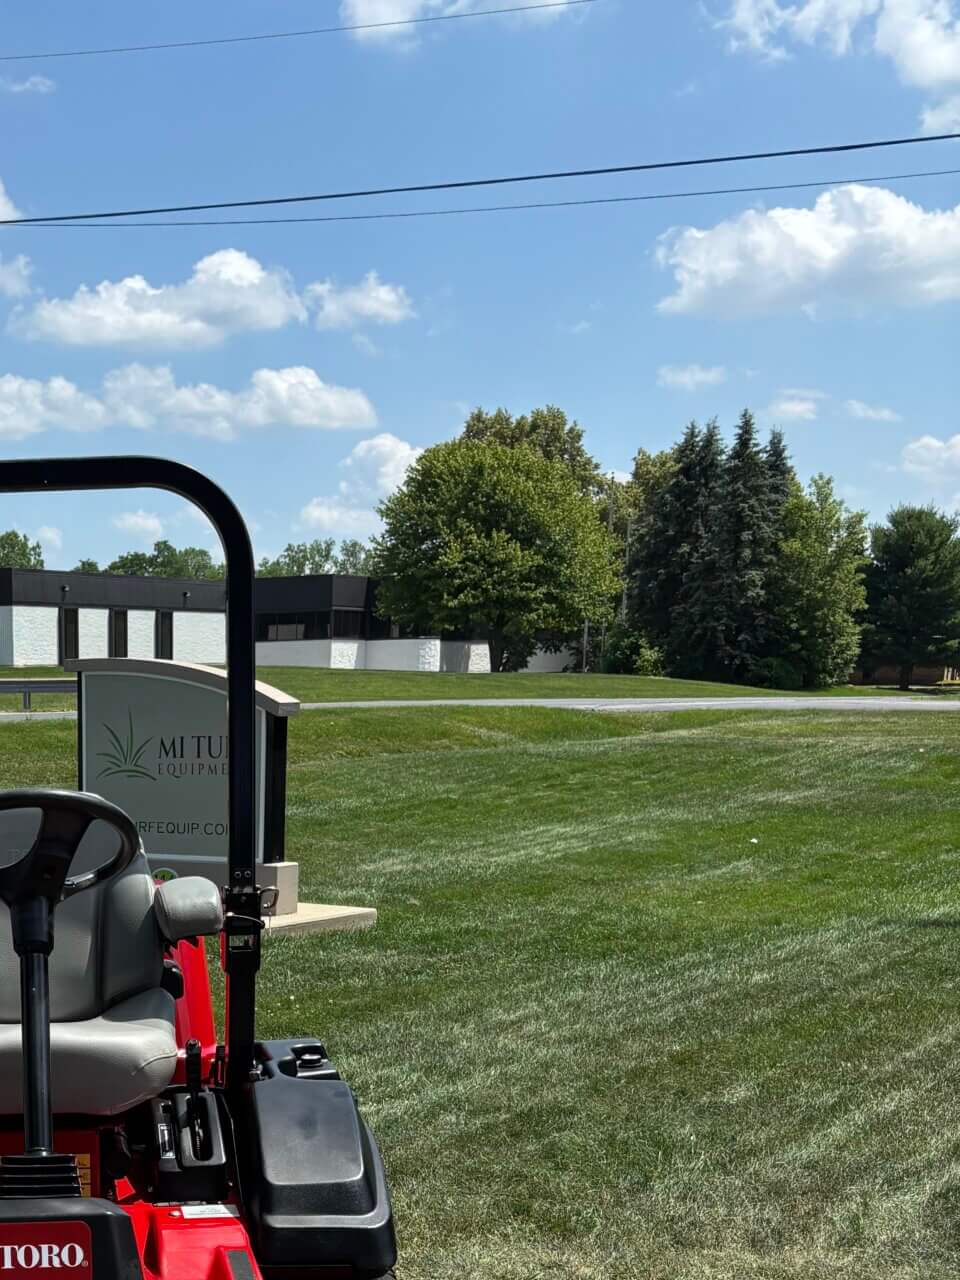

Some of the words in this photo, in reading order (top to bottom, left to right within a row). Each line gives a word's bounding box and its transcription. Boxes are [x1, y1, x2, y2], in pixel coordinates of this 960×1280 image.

[159, 735, 185, 759] MI
[191, 735, 229, 759] TU
[136, 821, 228, 836] RFEQUIP.CO
